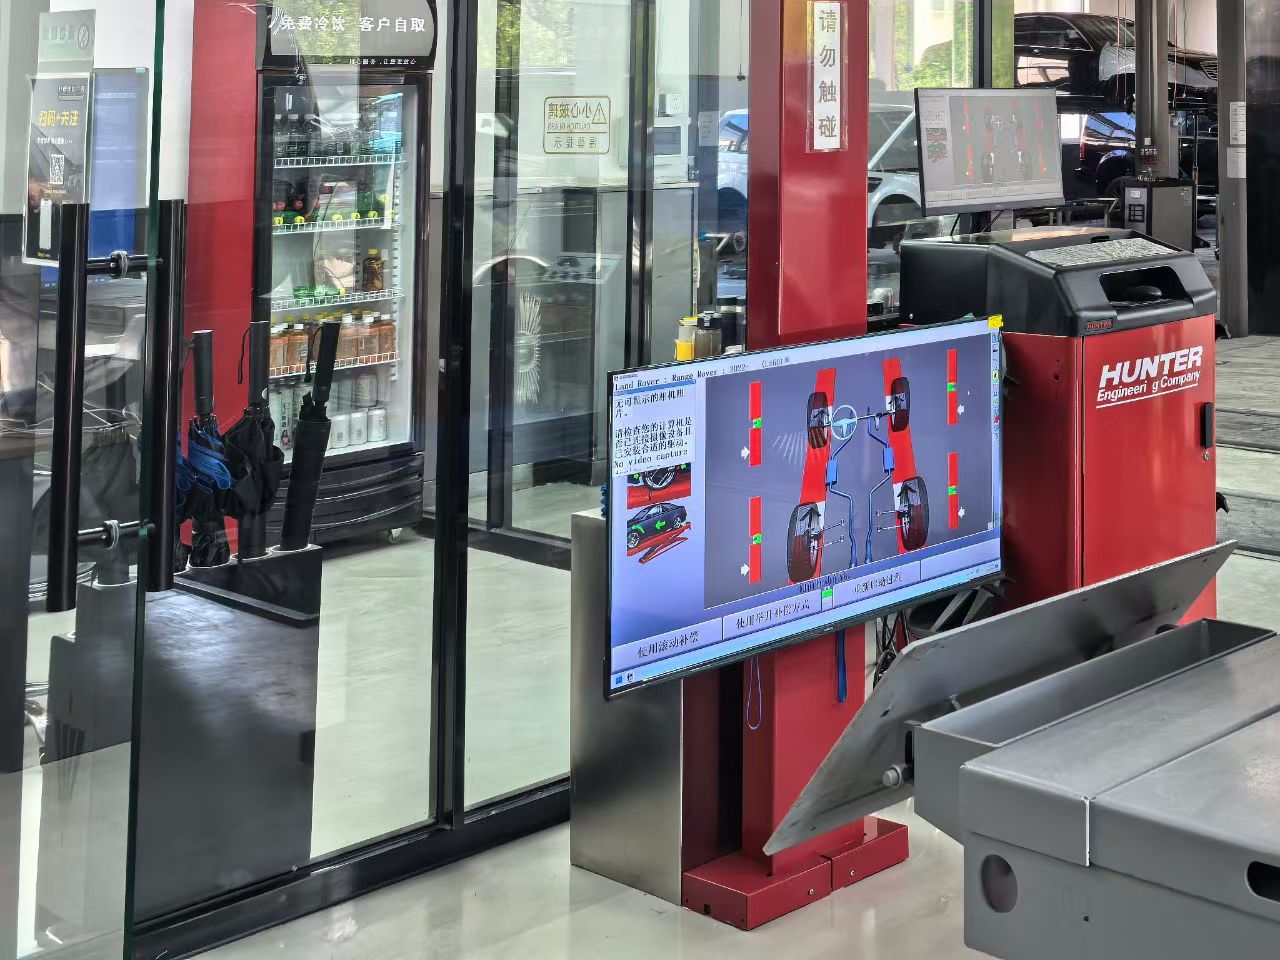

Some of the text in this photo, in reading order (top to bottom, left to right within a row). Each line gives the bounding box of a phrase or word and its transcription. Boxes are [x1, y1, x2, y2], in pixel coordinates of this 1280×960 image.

[280, 15, 426, 33] 免费冷饮 客户自取
[818, 9, 838, 139] 请勿触碰
[1099, 346, 1203, 388] HUNTER
[615, 381, 634, 391] Land
[637, 378, 660, 388] Rover
[697, 370, 717, 378] Rover
[1160, 370, 1201, 388] Company
[615, 449, 688, 468] No video capture
[638, 630, 699, 658] 使用滚动补偿
